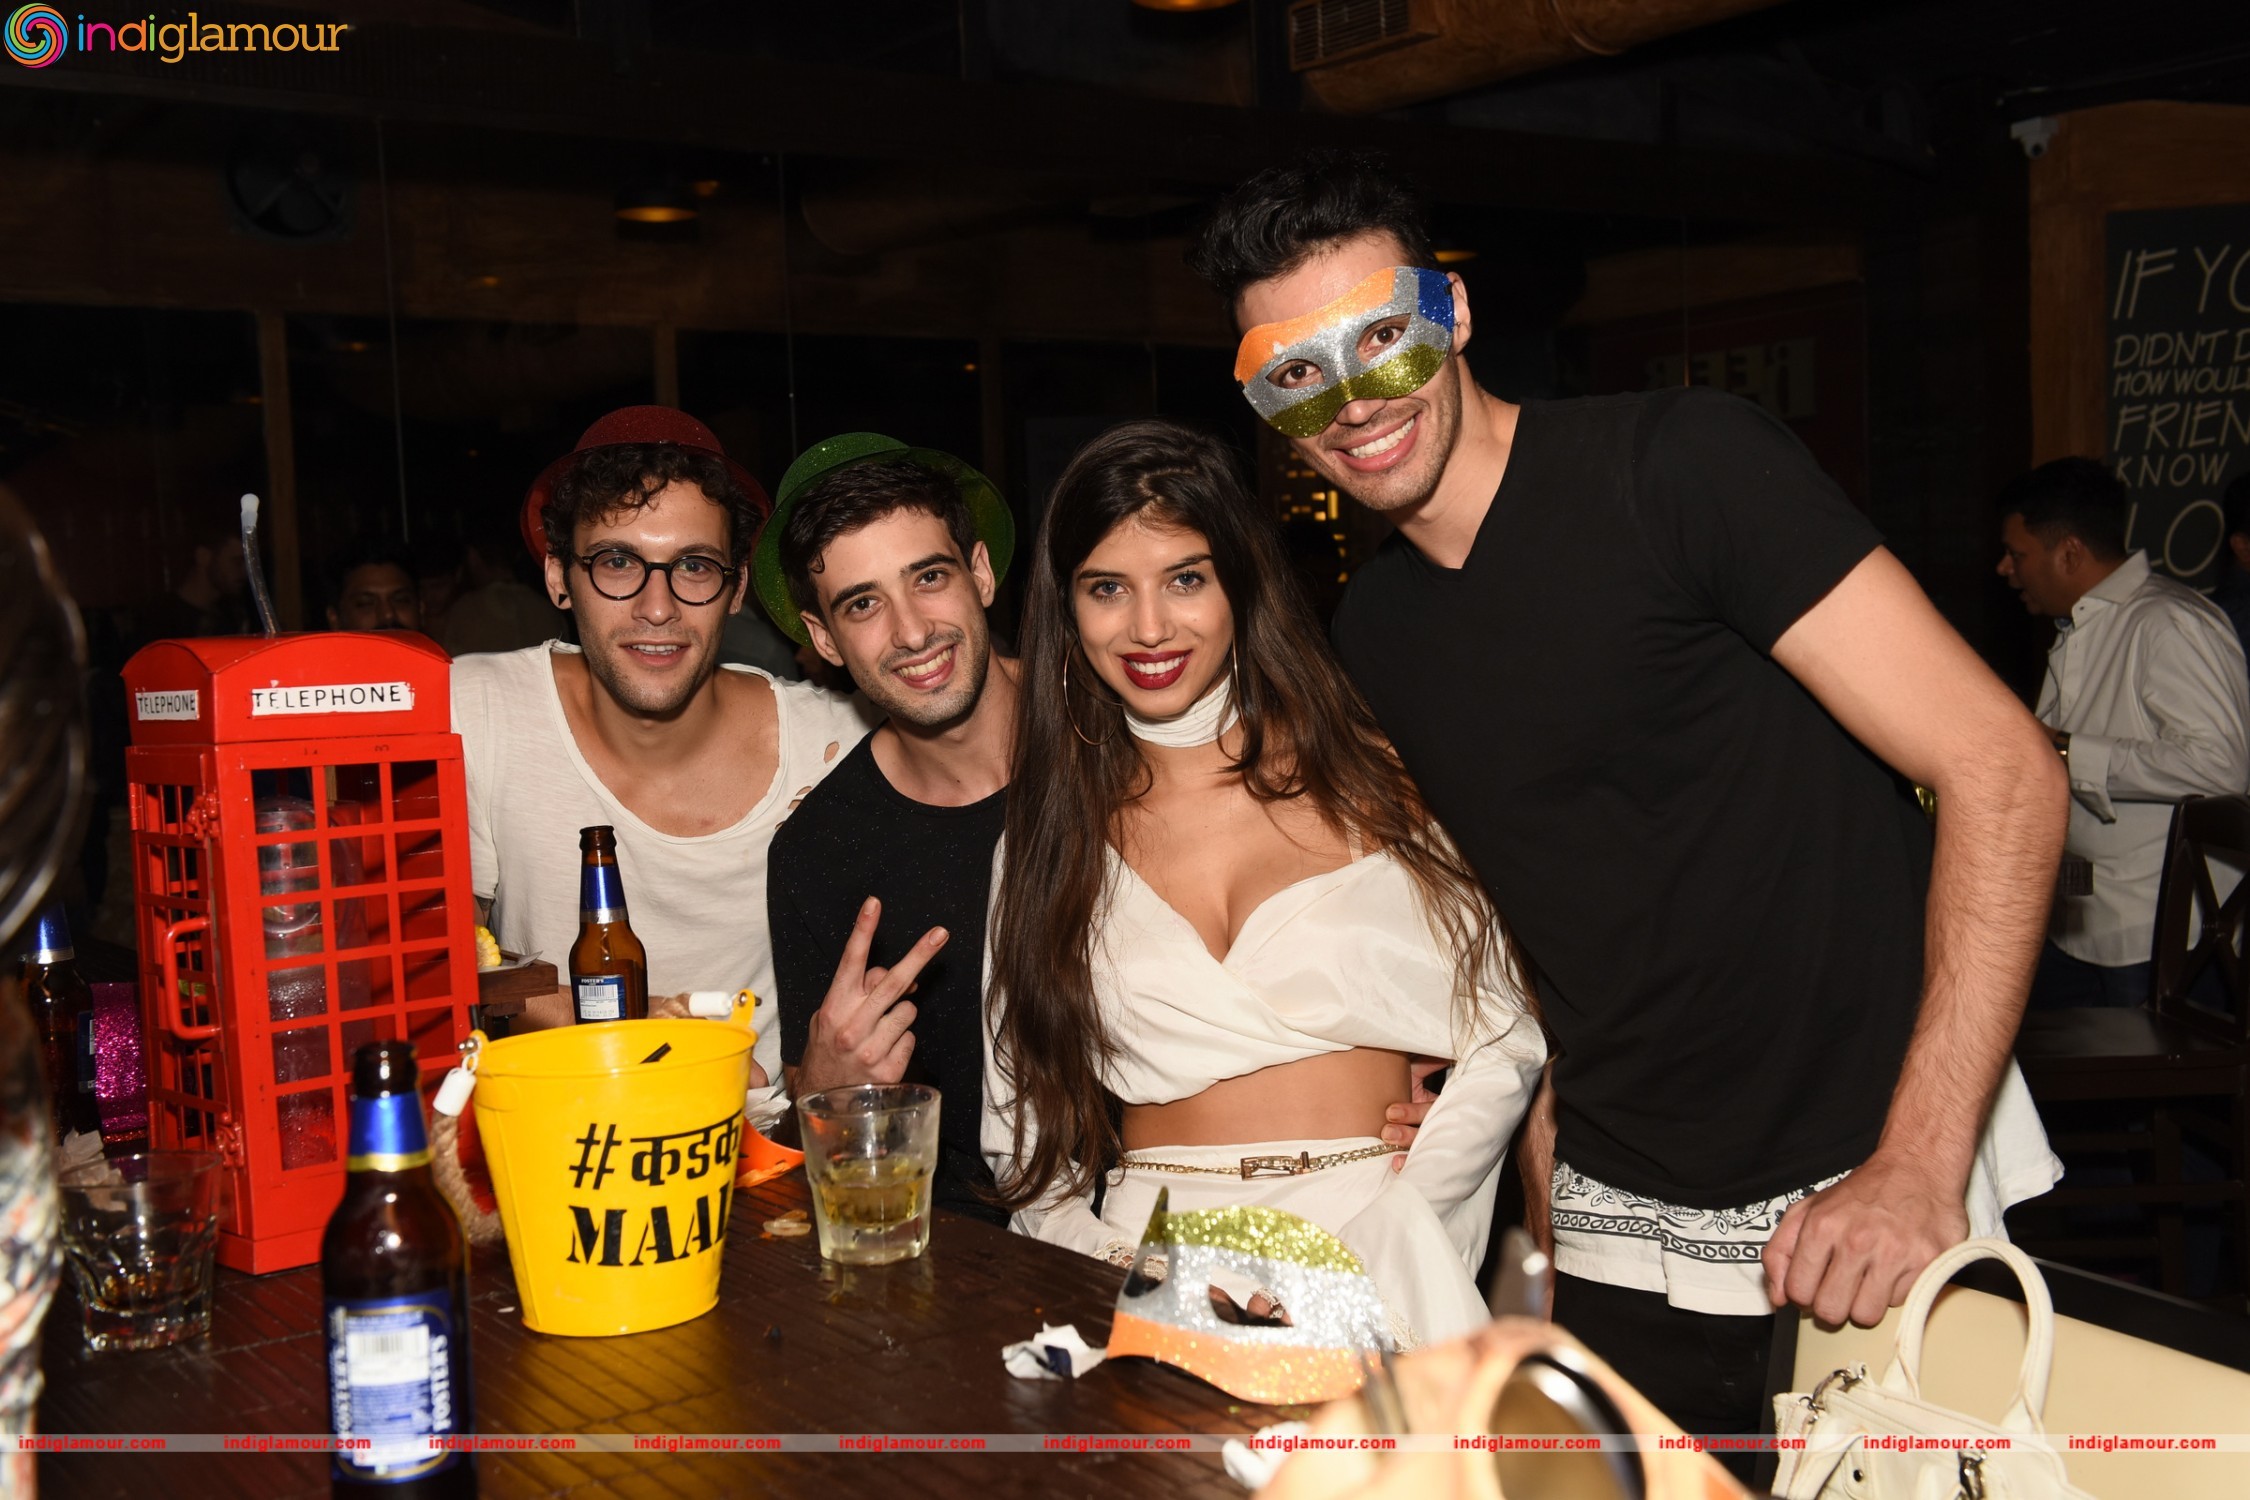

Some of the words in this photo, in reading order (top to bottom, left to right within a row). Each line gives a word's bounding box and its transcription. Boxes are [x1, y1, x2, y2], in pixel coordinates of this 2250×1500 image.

[2112, 248, 2178, 321] IF
[2113, 368, 2171, 398] HOW
[2173, 365, 2250, 394] WOUL
[2115, 452, 2230, 489] KNOW
[137, 693, 196, 714] TELEPHONE
[252, 684, 402, 708] TELEPHONE
